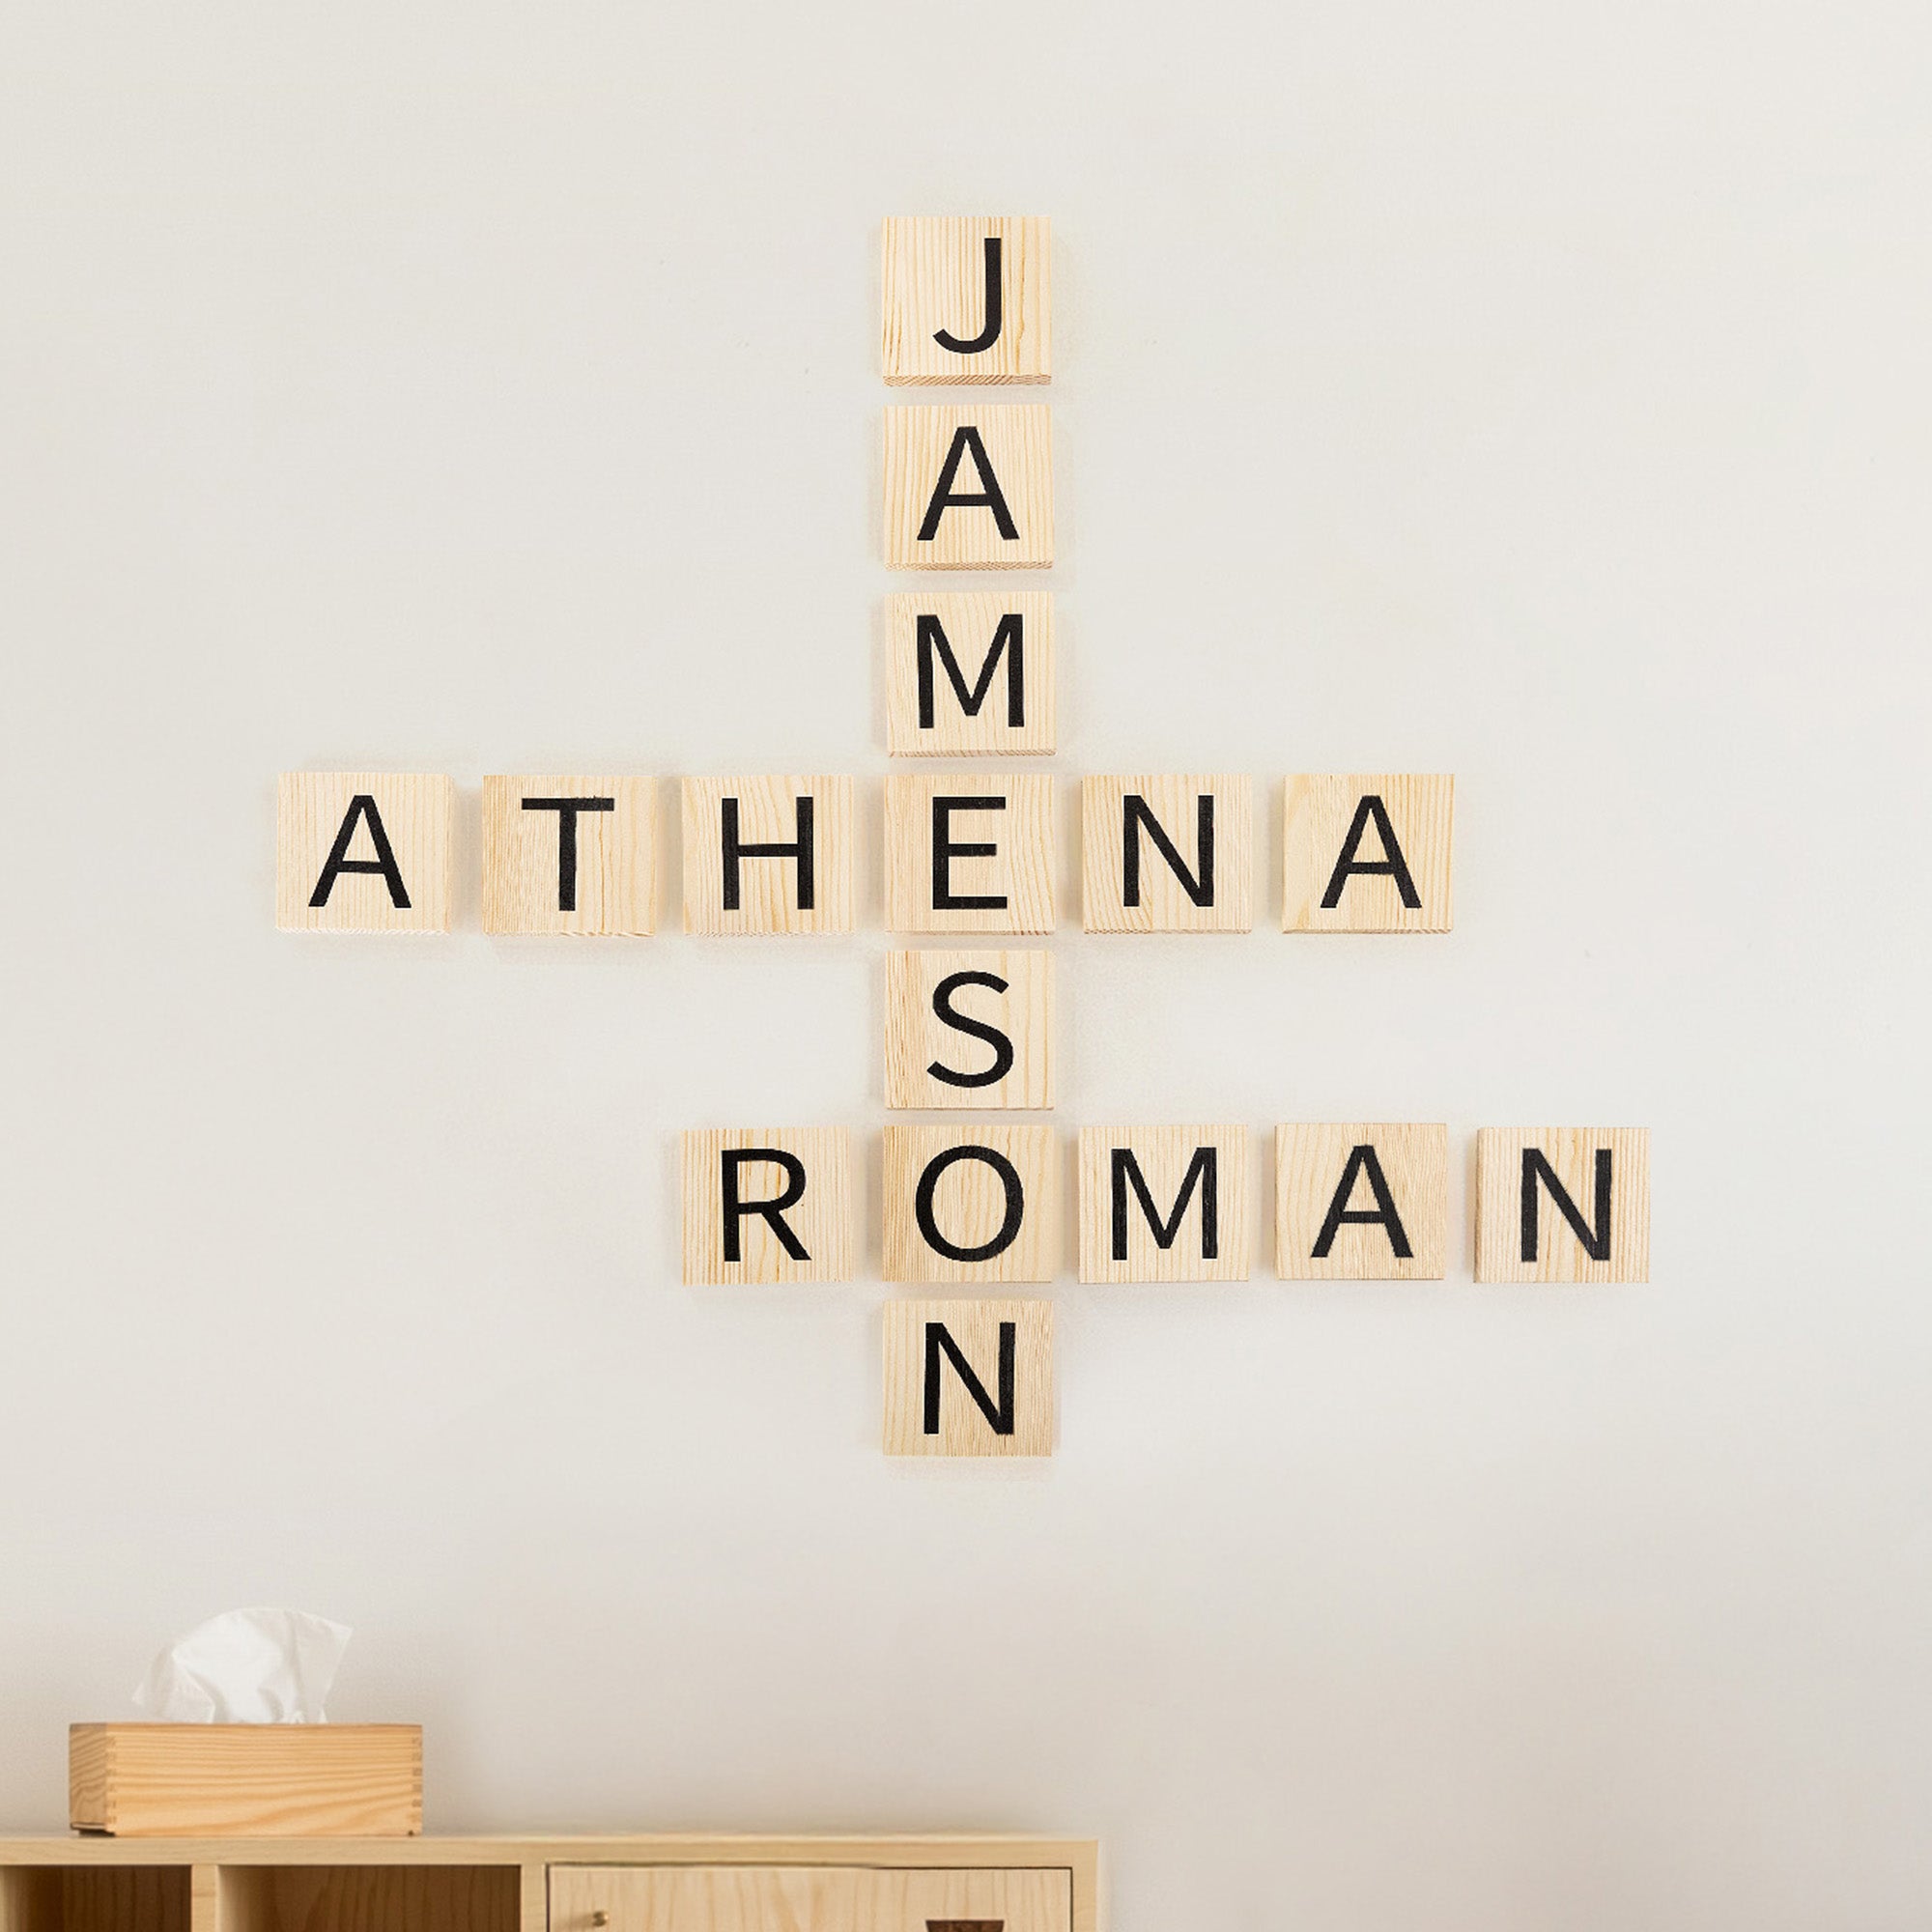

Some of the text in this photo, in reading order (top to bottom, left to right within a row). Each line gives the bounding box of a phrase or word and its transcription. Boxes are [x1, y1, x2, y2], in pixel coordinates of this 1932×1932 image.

[308, 795, 1423, 912] ATHENA
[915, 238, 1025, 1435] JAMESON
[721, 1144, 1612, 1263] ROMAN
